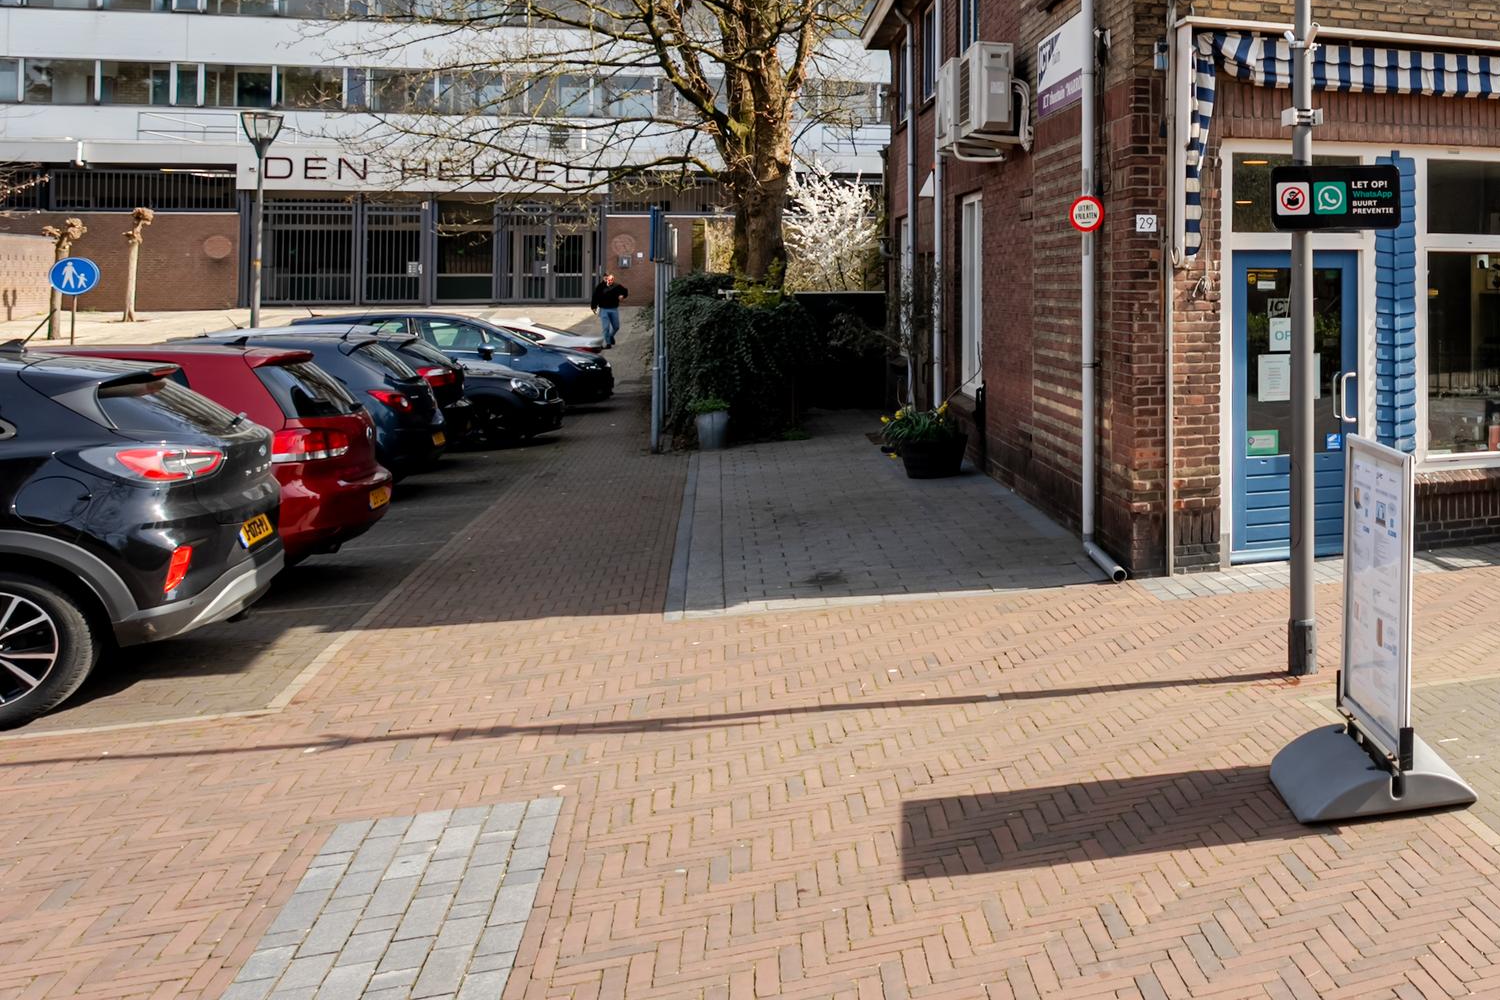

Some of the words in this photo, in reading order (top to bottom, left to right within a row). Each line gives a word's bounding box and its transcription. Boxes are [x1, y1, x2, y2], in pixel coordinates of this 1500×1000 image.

[264, 156, 368, 180] DEN
[401, 157, 586, 184] HEUVEL
[1352, 181, 1368, 189] LET
[1371, 180, 1388, 188] OP!
[1352, 190, 1393, 198] WhatsApp
[1139, 217, 1154, 230] 29
